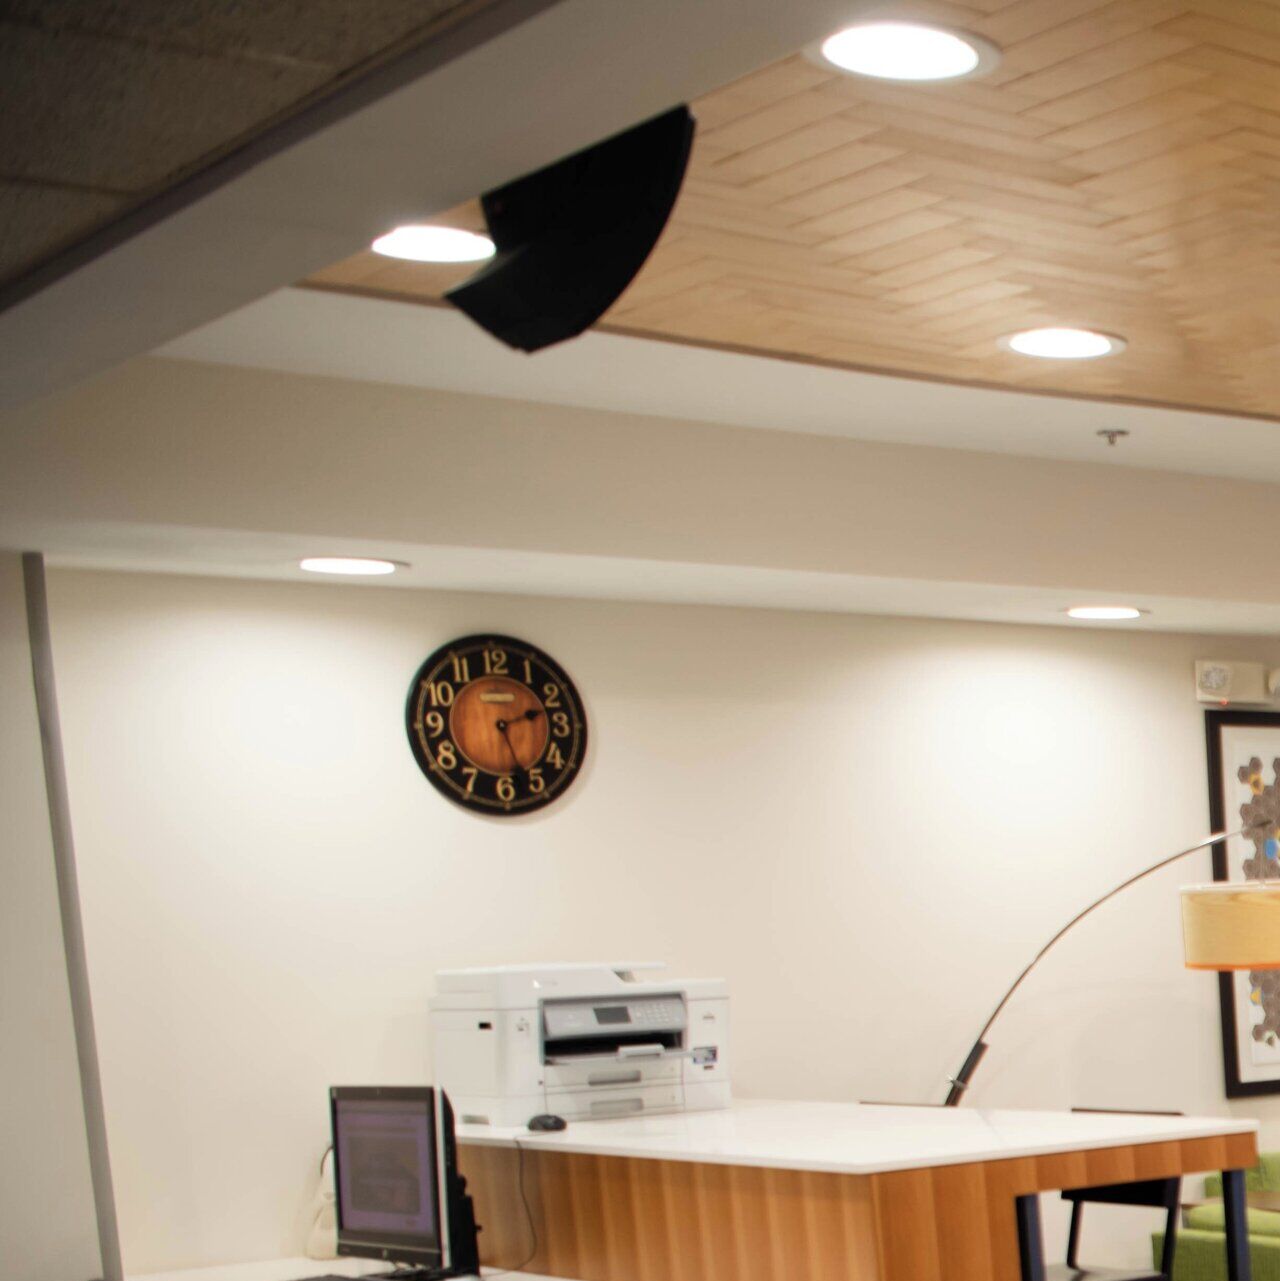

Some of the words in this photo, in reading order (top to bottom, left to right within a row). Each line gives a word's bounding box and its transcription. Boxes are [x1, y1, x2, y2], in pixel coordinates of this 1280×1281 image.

[453, 657, 470, 683] 11
[482, 650, 508, 675] 12
[524, 659, 533, 684] 1
[429, 682, 454, 707] 10
[543, 684, 561, 708] 2
[425, 711, 444, 738] 9
[552, 712, 571, 738] 3
[437, 740, 457, 770] 8
[546, 742, 565, 770] 4
[462, 767, 478, 793] 7
[496, 777, 516, 801] 6
[529, 768, 545, 793] 5
